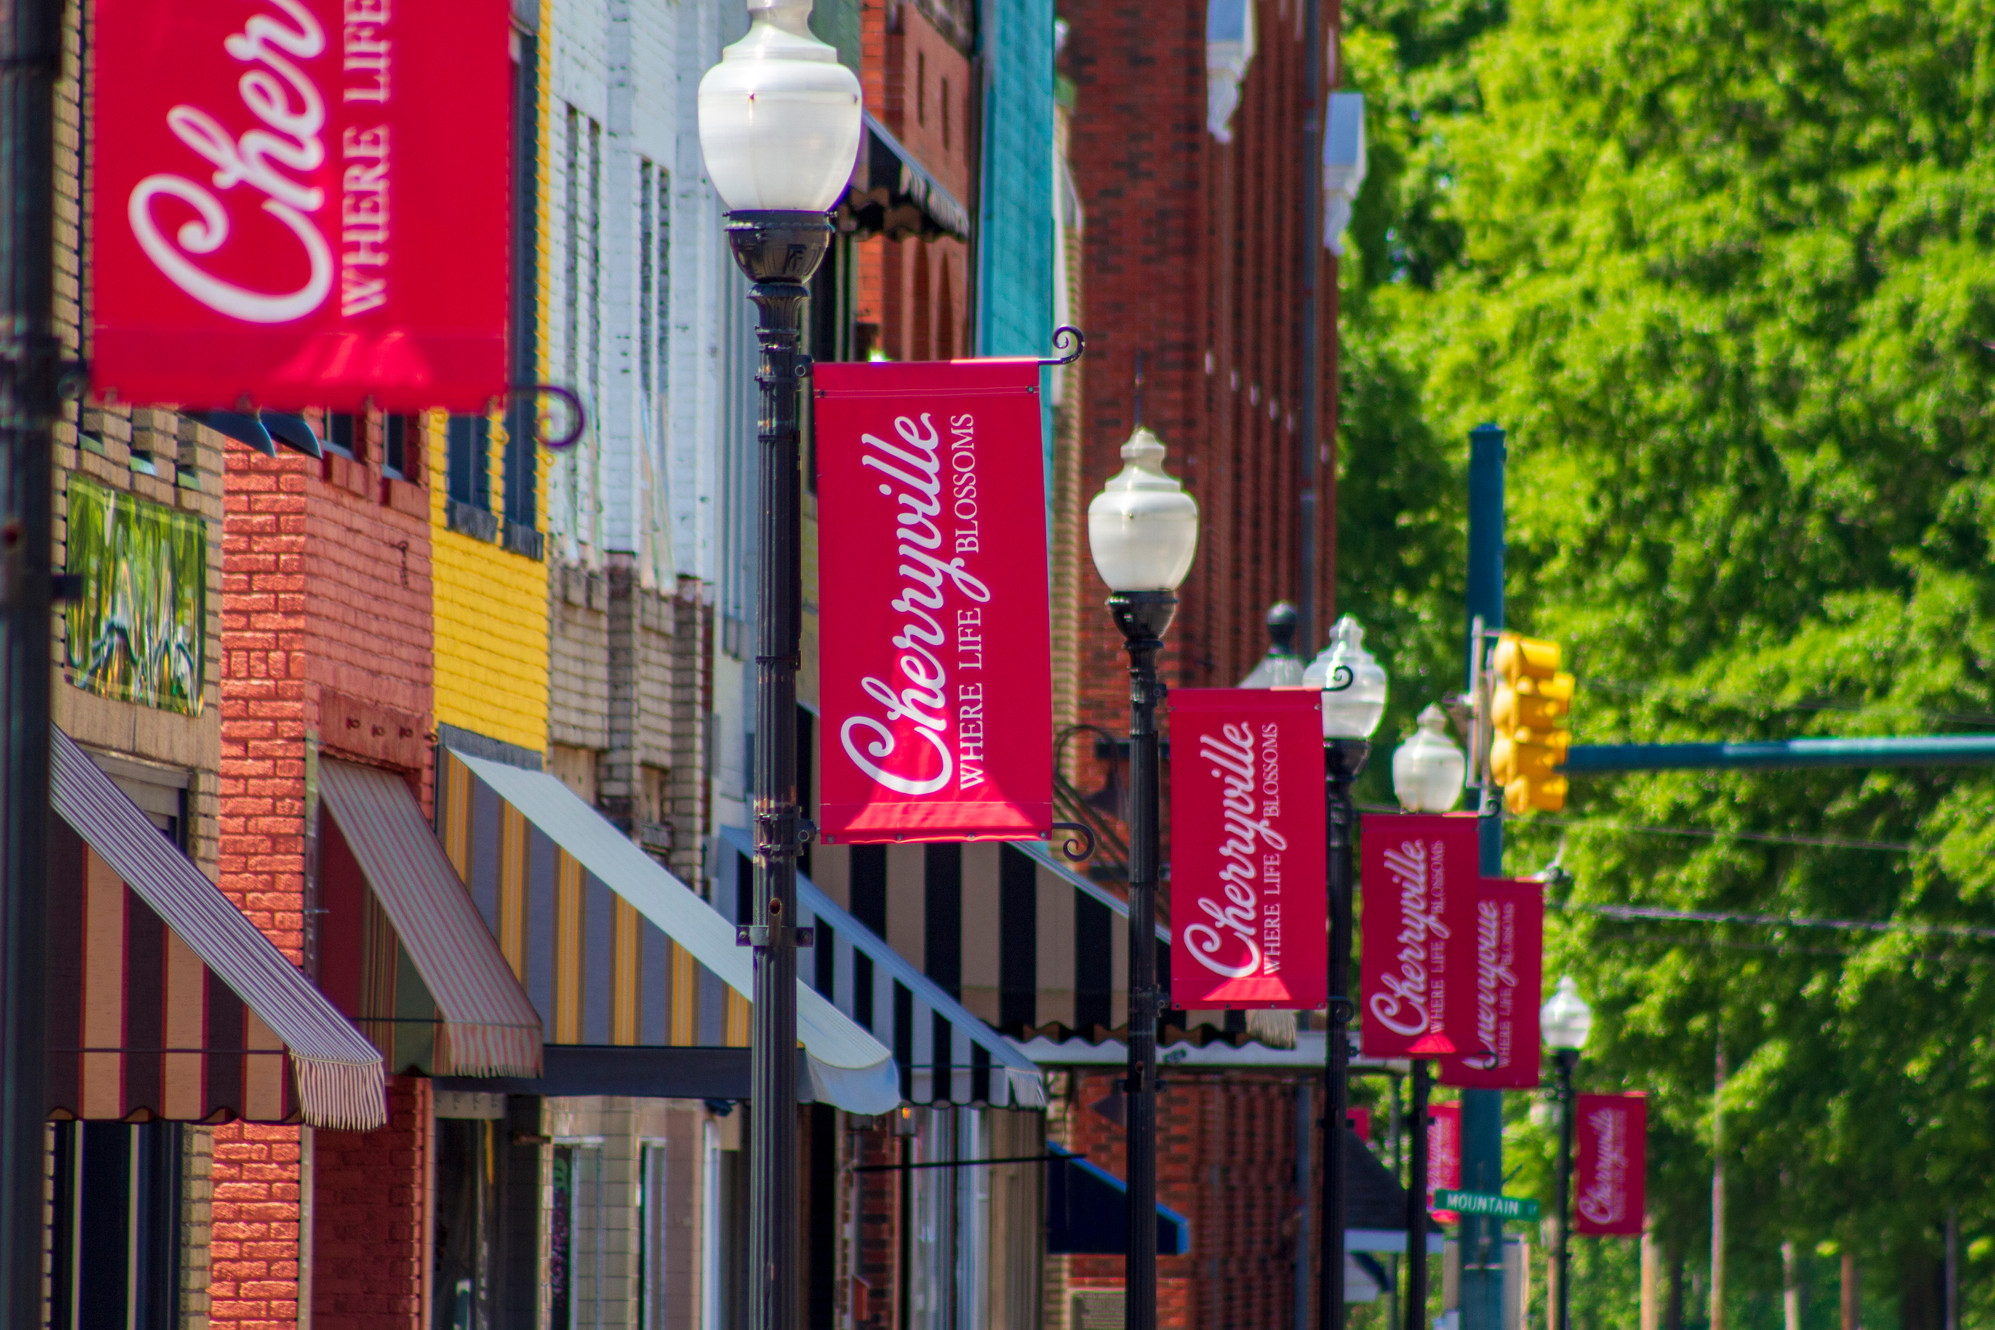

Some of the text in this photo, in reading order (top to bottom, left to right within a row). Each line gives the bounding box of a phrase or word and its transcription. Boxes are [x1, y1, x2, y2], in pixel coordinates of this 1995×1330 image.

[341, 125, 390, 317] WHERE
[841, 412, 990, 795] Cherryville
[950, 413, 983, 790] WHERE LIFE BLOSSOMS
[1183, 720, 1287, 978] Cherryville
[1262, 723, 1281, 975] WHERE LIFE BLOSSOMS
[1369, 839, 1450, 1036] Cherryville
[1430, 840, 1444, 1034] WHERE LIFE BLOSSOMS
[1447, 1193, 1519, 1215] MOUNTAIN
